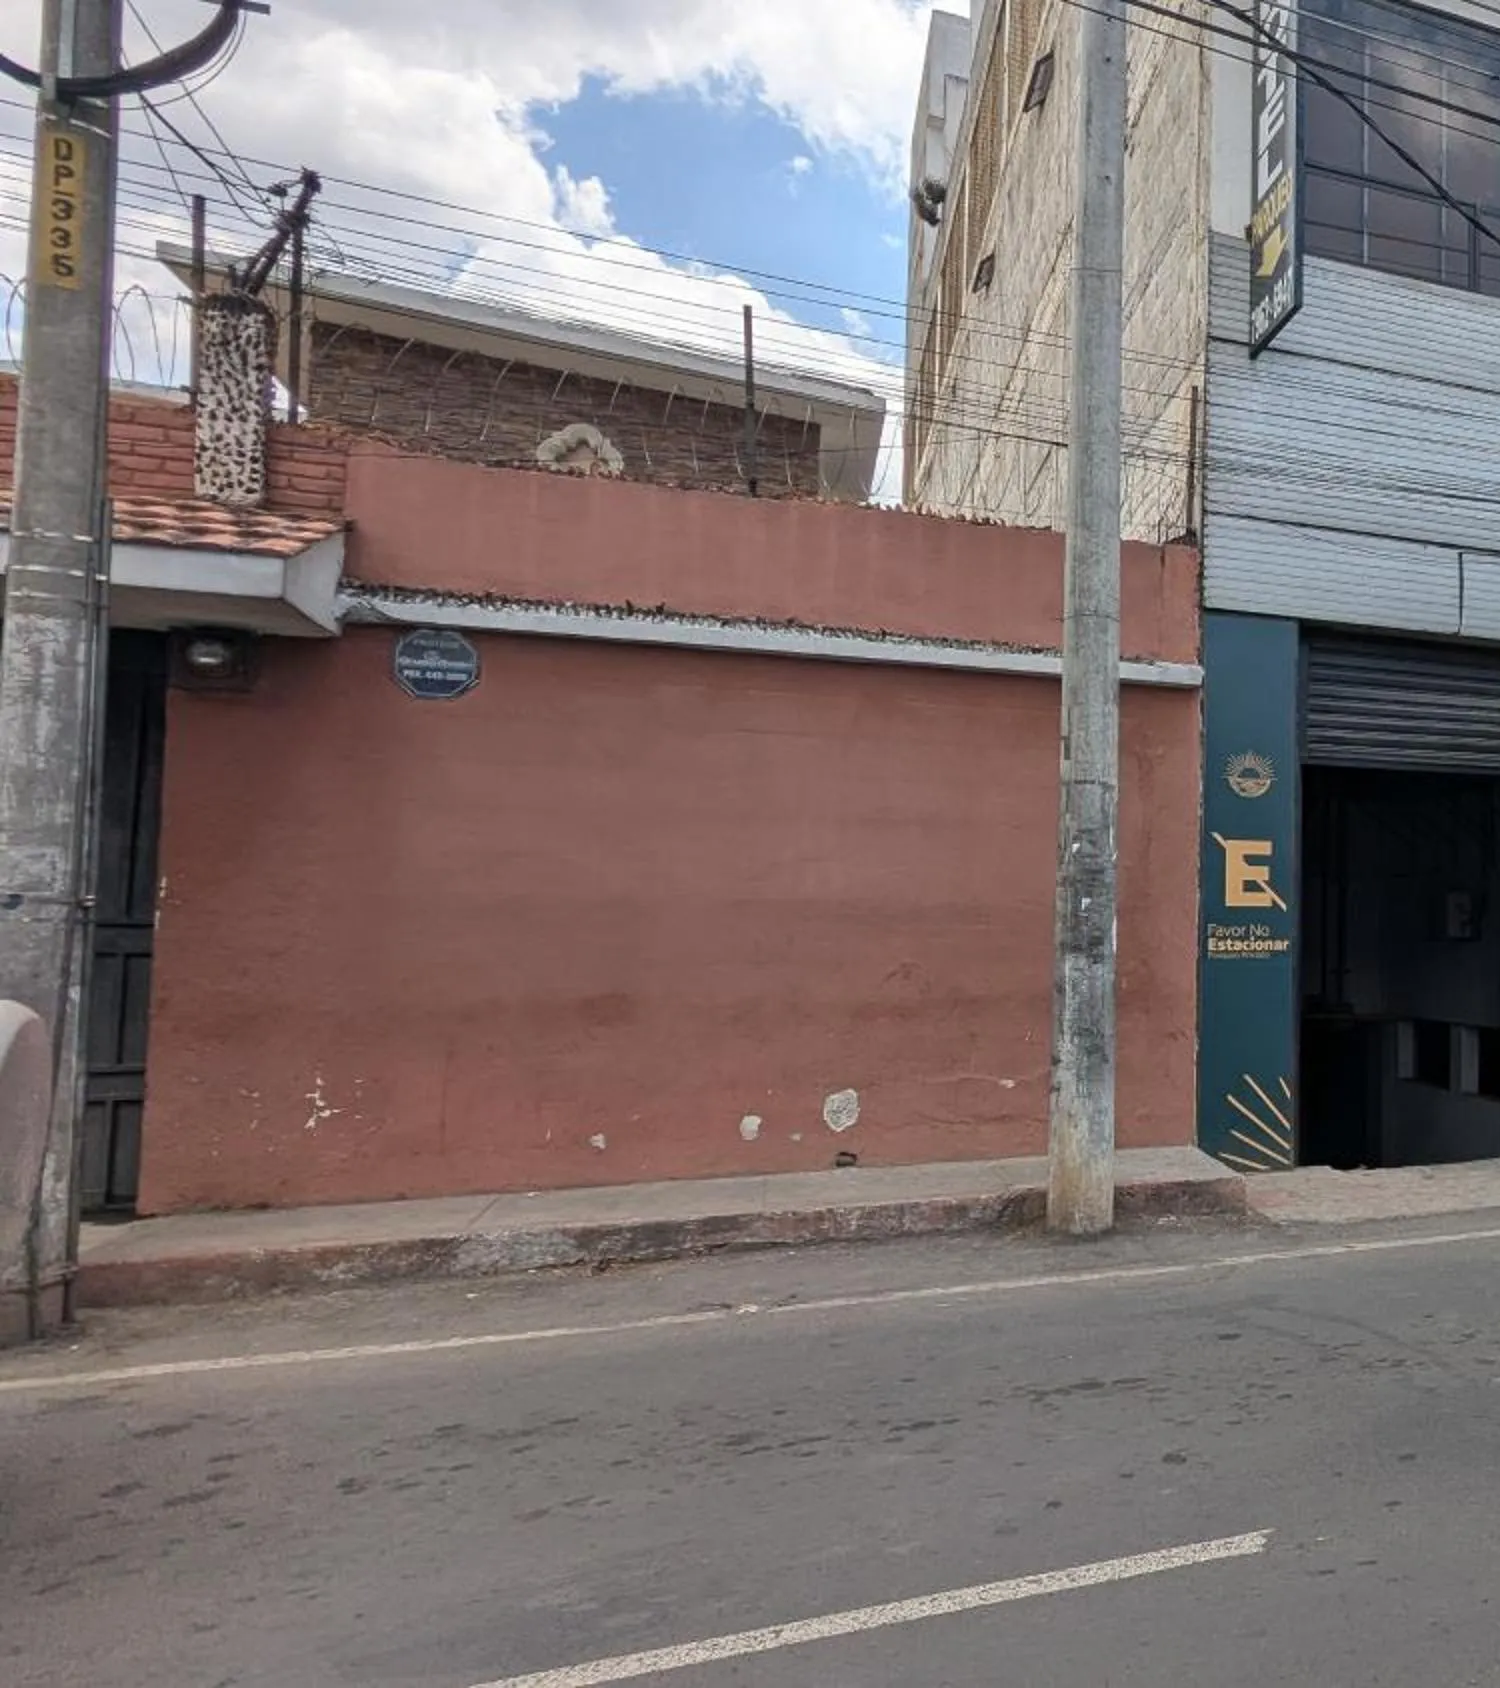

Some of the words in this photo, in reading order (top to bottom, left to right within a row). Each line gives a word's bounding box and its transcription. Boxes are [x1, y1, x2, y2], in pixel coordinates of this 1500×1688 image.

[1207, 923, 1247, 937] Favor
[1250, 923, 1270, 937] No
[1207, 936, 1289, 952] Estacionar
